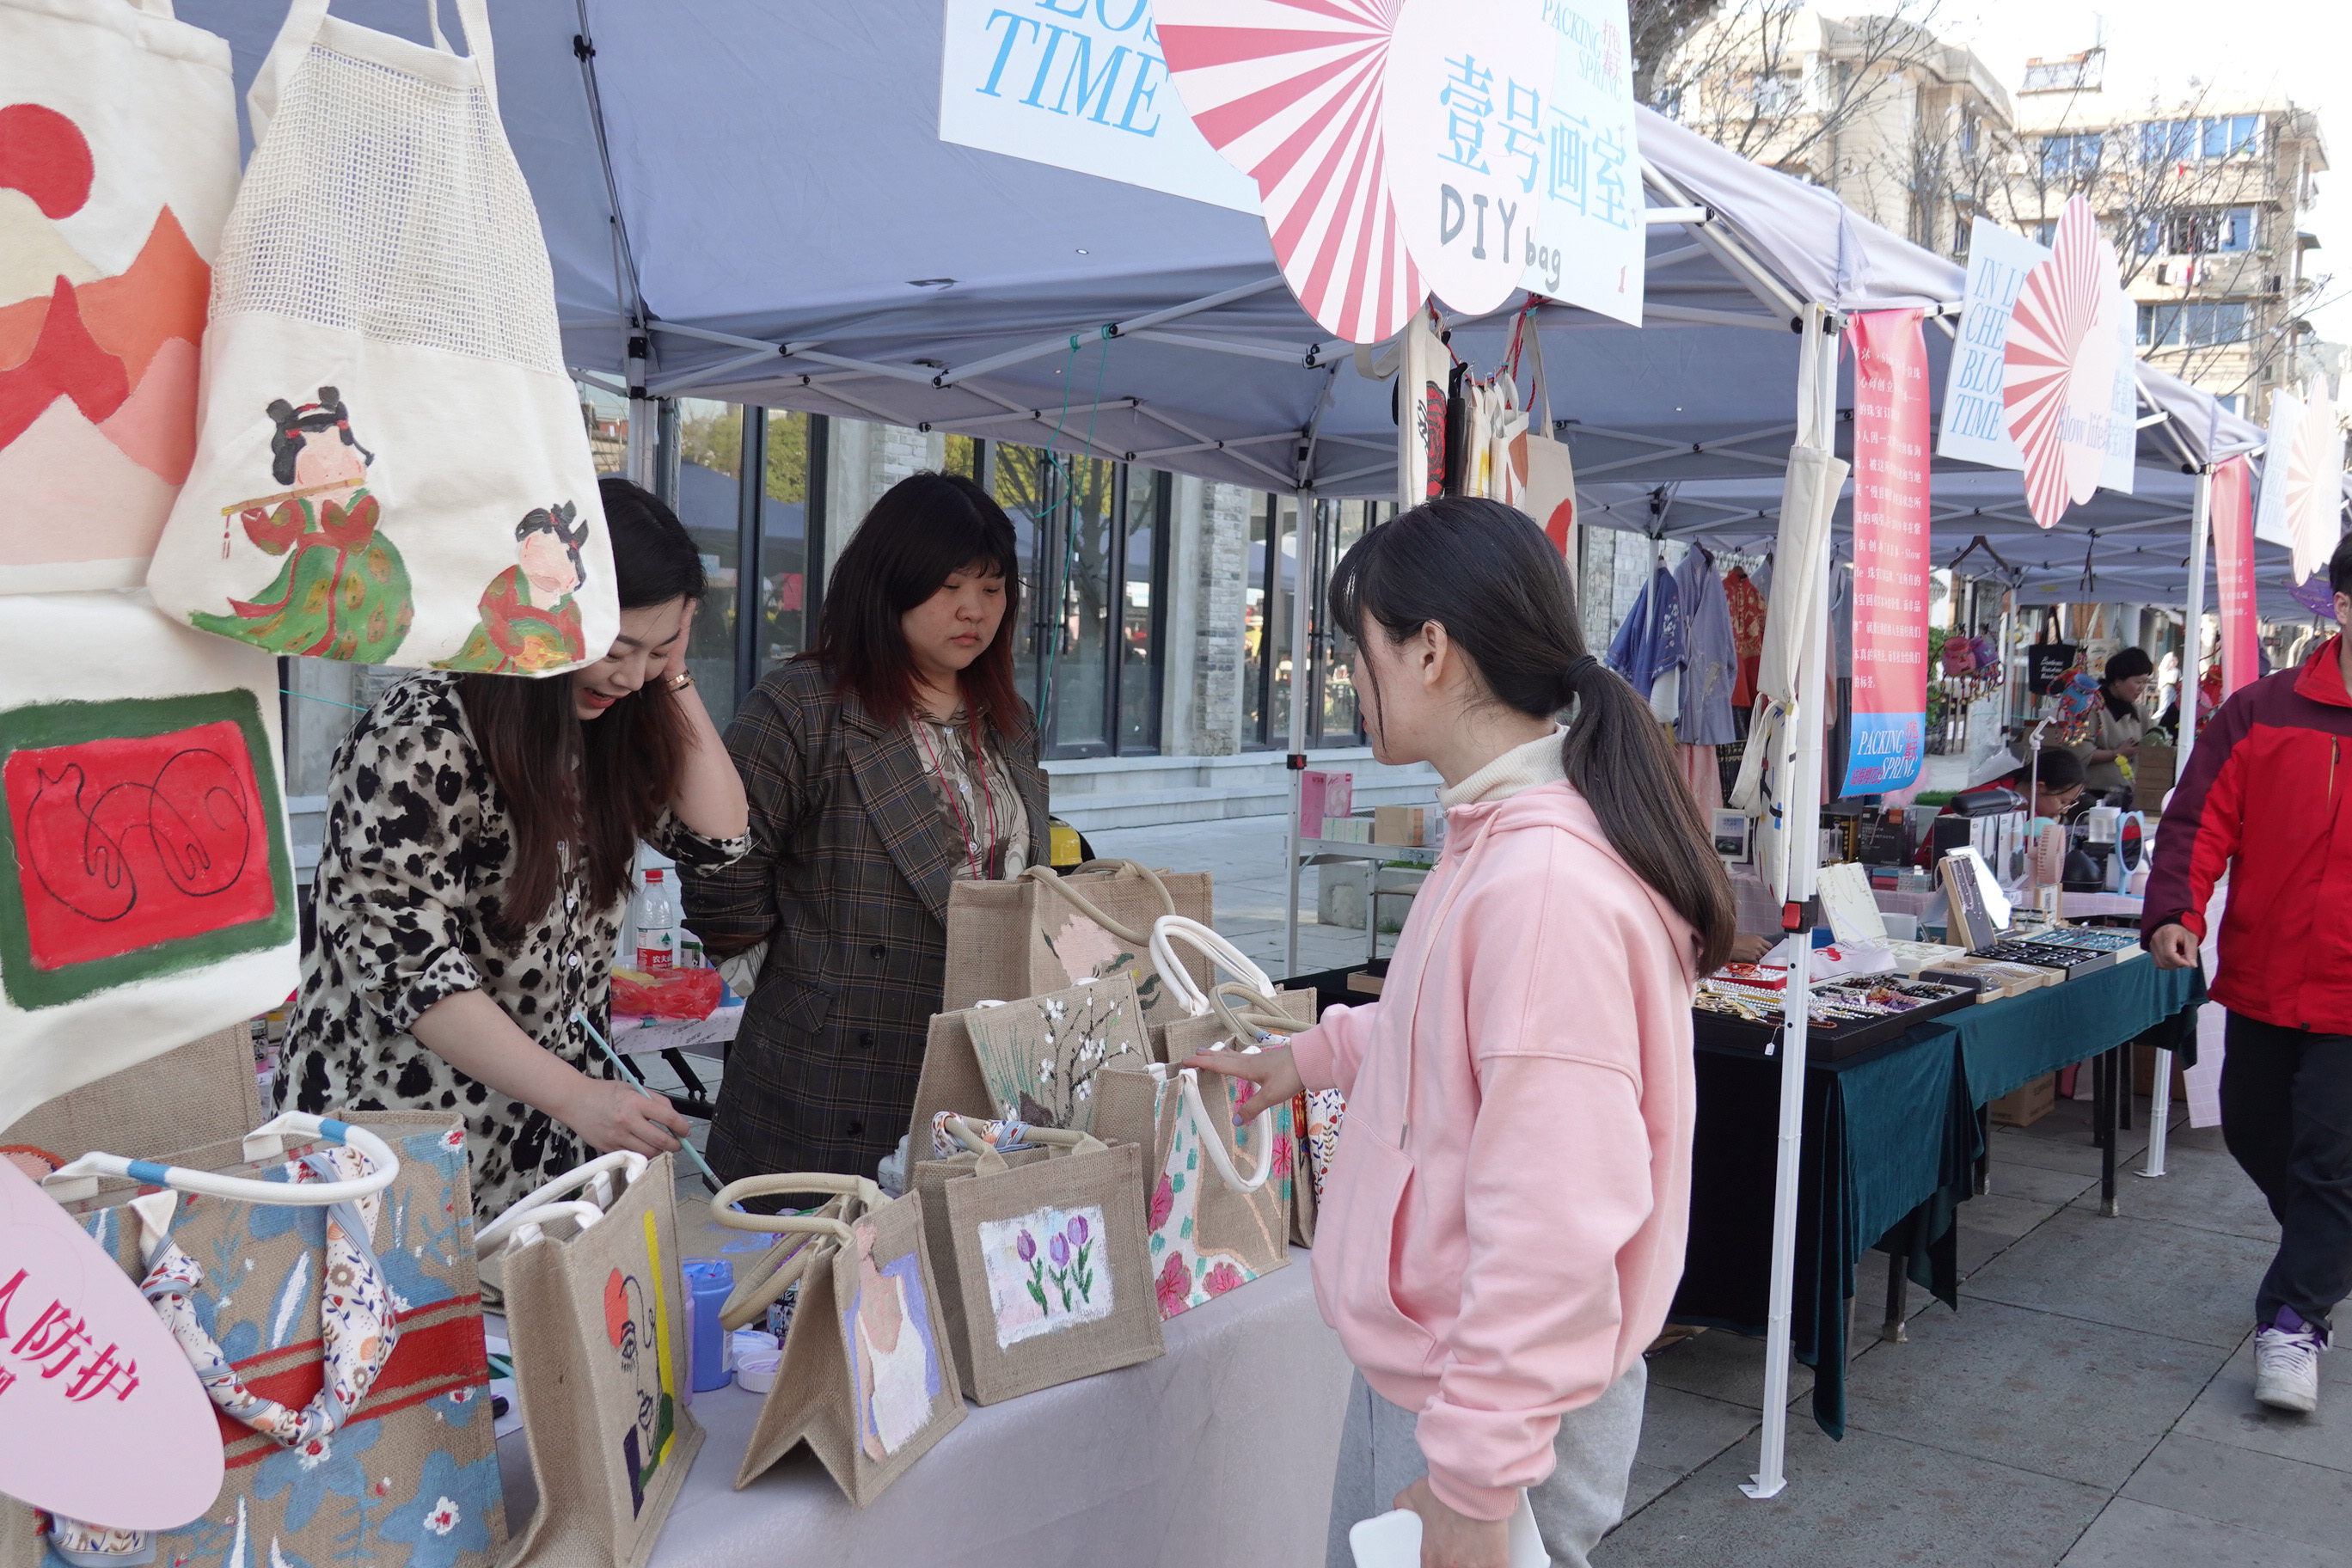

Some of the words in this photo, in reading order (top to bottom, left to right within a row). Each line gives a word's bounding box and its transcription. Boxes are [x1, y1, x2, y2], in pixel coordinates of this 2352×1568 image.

[1540, 0, 1602, 58] PACKING
[976, 9, 1170, 138] TIME
[1577, 49, 1622, 102] SPRING
[1437, 53, 1629, 231] 壹号画室
[1440, 183, 1517, 265] DIY
[1525, 226, 1561, 293] bag
[1974, 257, 2004, 299] IN
[1965, 302, 2010, 352] CHE
[1957, 349, 2004, 395] BLO
[1950, 393, 2004, 442] TIME
[1857, 729, 1905, 756] PACKING
[1877, 756, 1918, 781] SPRING
